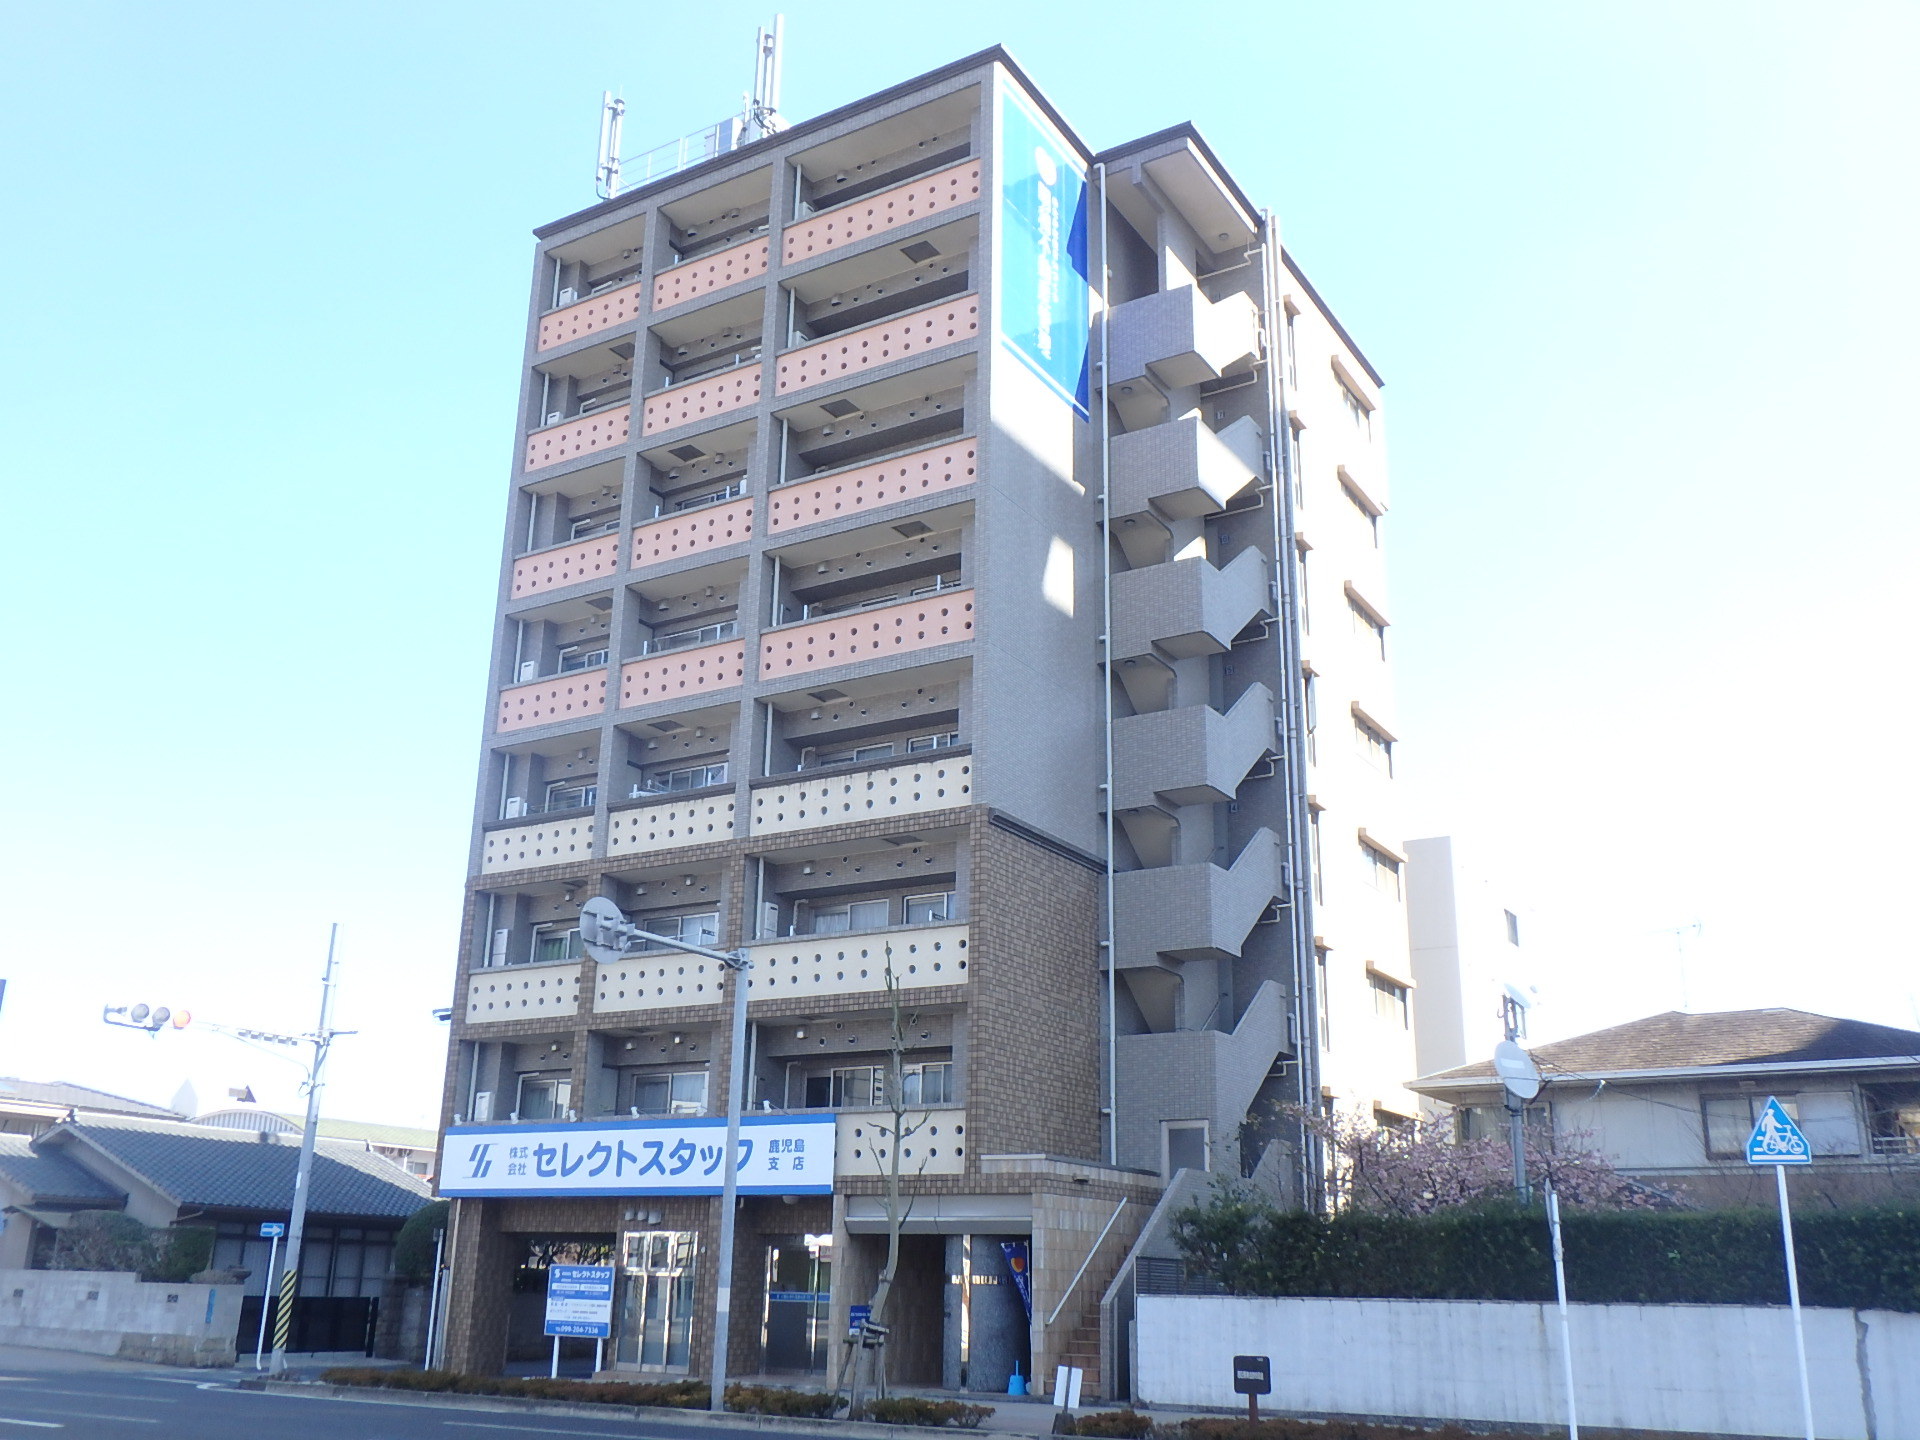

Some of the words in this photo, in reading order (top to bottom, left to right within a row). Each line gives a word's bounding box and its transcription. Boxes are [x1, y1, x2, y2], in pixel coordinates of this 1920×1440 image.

[509, 1146, 528, 1160] 株式
[768, 1138, 805, 1153] 鹿児島
[507, 1162, 526, 1177] 会社
